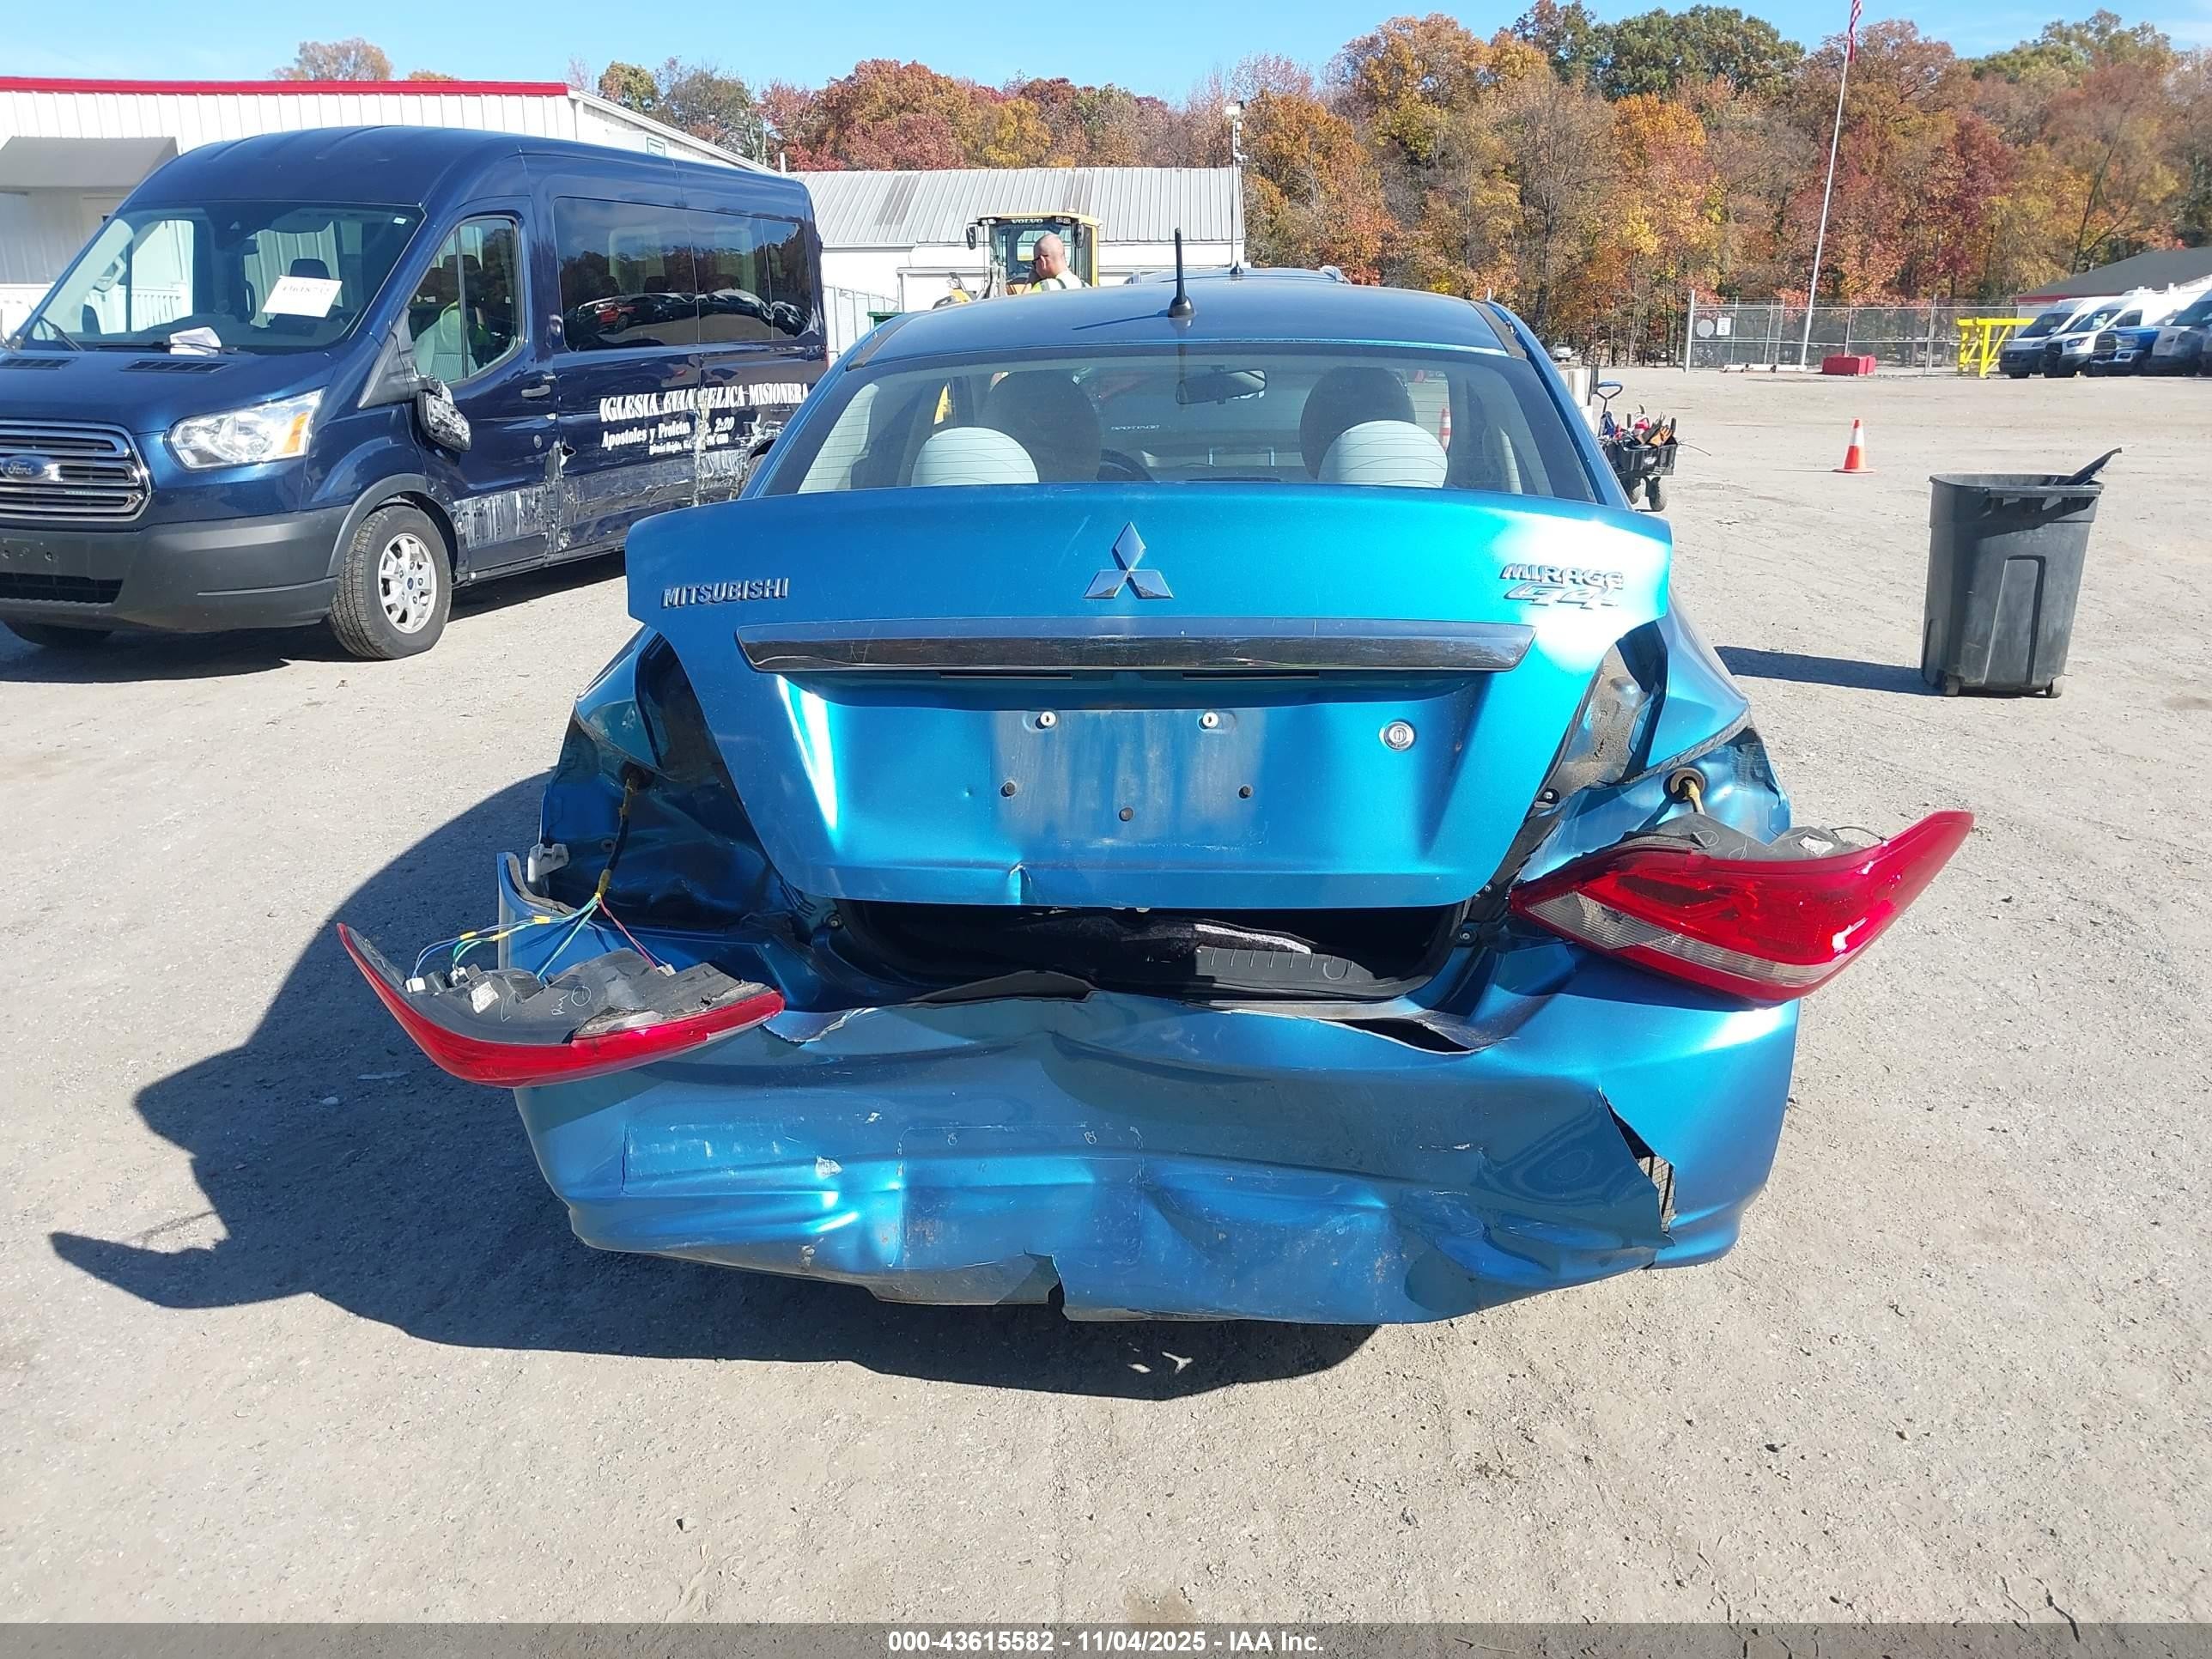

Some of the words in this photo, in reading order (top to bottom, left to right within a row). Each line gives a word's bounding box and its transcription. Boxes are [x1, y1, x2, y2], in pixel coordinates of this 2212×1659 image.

[600, 392, 659, 422] IGLESIA
[748, 382, 810, 404] MISIONERA
[601, 427, 647, 452] Apostoles
[648, 428, 656, 445] y
[8, 460, 34, 476] Ford
[1498, 562, 1625, 589] MIRAGE
[661, 577, 789, 609] MITSUBISHI
[1504, 581, 1620, 611] G4
